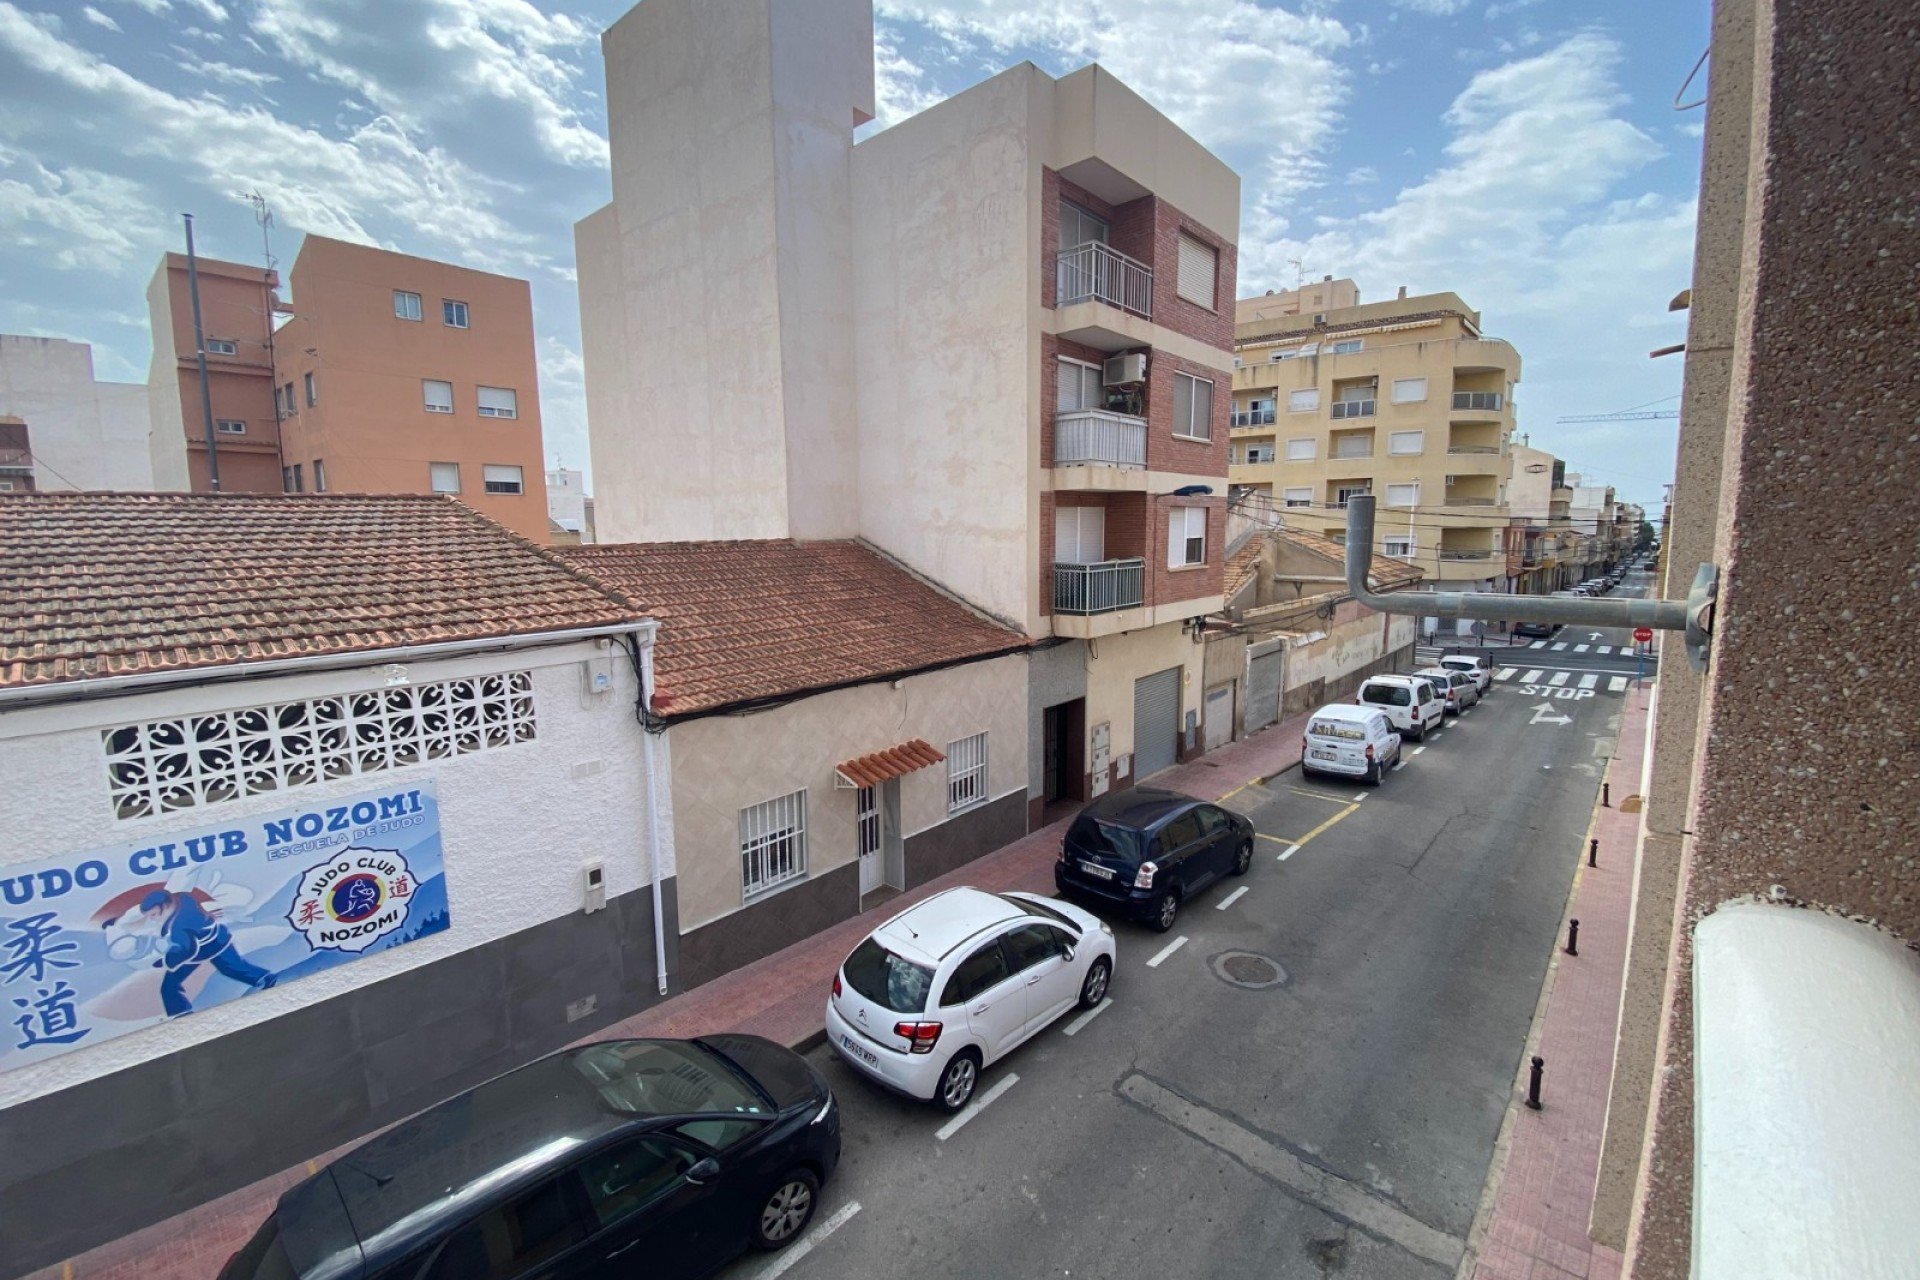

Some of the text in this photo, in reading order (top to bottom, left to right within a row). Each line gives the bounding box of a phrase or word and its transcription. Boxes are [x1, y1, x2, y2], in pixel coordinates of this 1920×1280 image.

[1519, 684, 1596, 700] STOP
[0, 790, 423, 905] UDO CLUB NOZOMI
[267, 814, 426, 862] ESCUELA DE JUDO
[311, 857, 397, 896] JUDO CLUB
[388, 875, 411, 899] 道
[298, 899, 325, 926] 柔
[320, 909, 398, 943] NOZOMI
[0, 911, 92, 1050] 柔道
